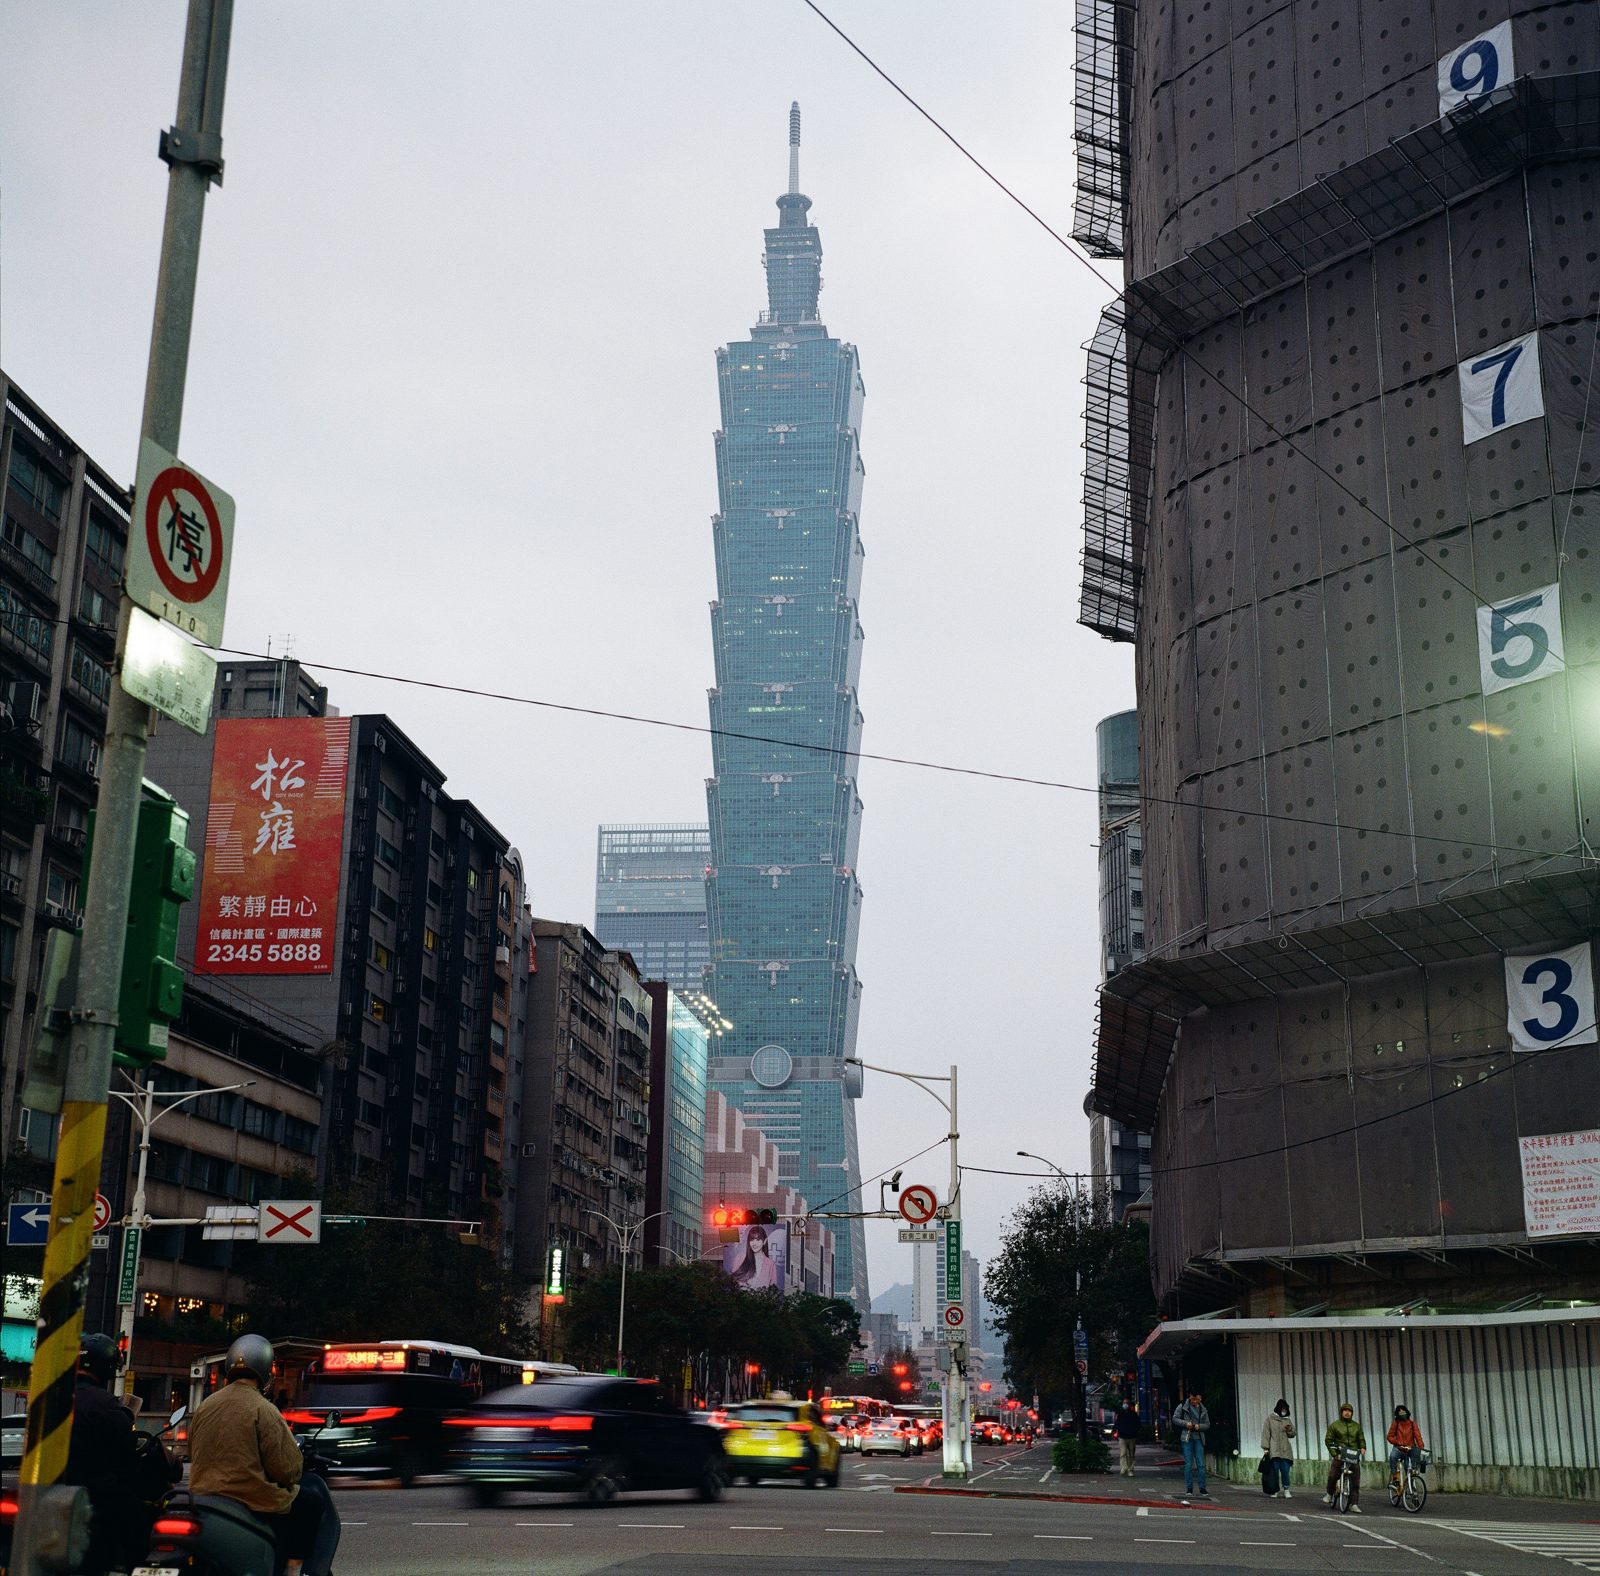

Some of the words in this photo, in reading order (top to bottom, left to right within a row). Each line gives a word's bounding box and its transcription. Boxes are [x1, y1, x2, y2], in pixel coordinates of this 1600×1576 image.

[1449, 39, 1499, 111] 9
[1471, 345, 1523, 428] 7
[166, 503, 205, 572] 停
[1490, 594, 1549, 680] 5
[180, 708, 201, 730] ZONE
[219, 895, 317, 918] 繁靜由心
[207, 944, 262, 962] 2345
[267, 943, 321, 962] 5888
[1521, 957, 1579, 1042] 3
